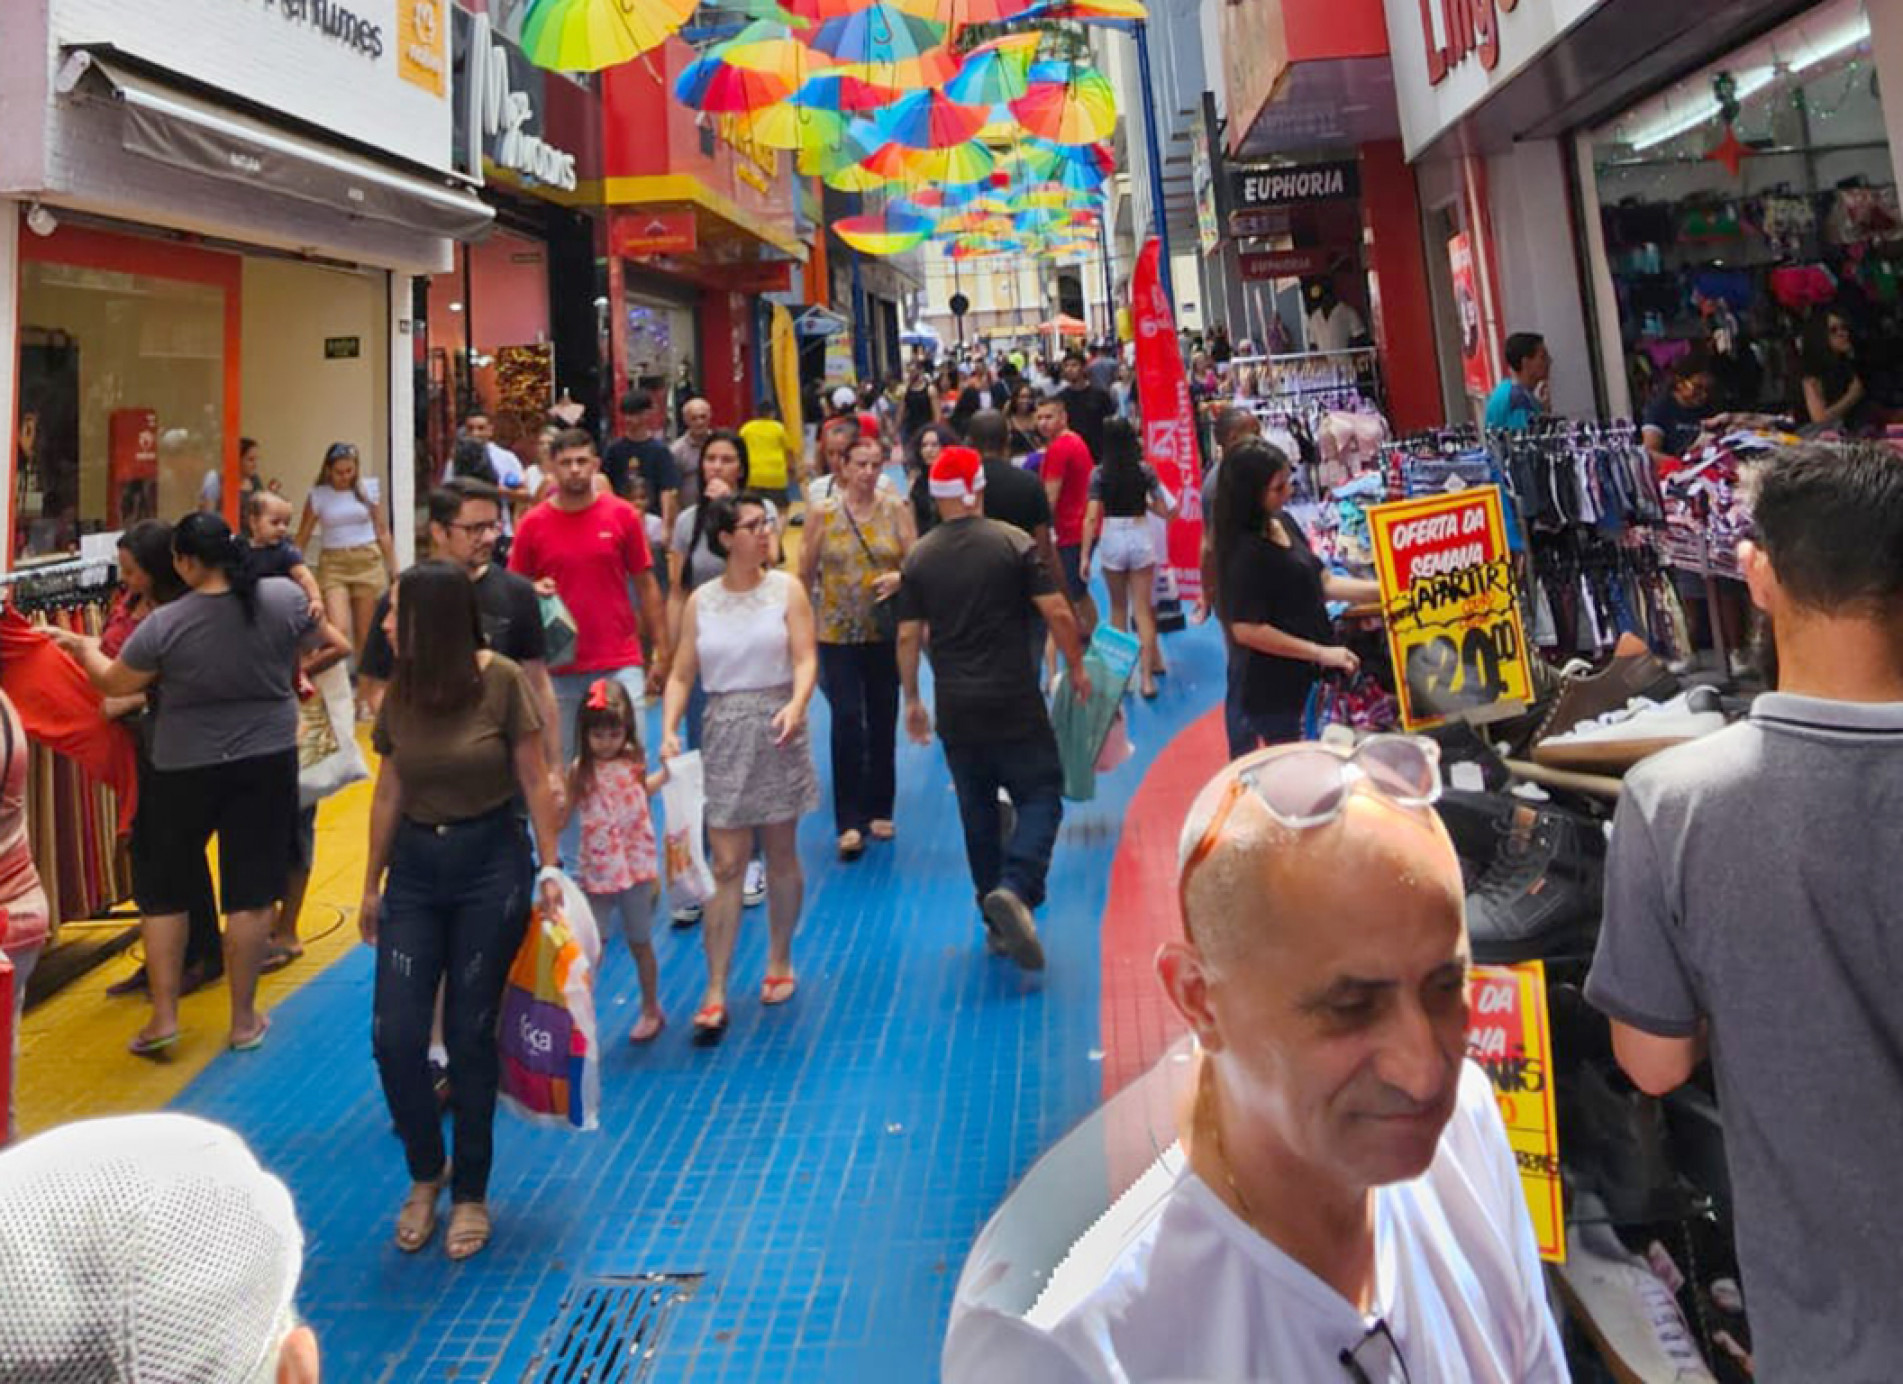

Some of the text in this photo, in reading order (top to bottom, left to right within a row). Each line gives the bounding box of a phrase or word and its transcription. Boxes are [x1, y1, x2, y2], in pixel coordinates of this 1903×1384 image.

[265, 0, 383, 58] erfumes
[1418, 0, 1518, 87] Ling
[1244, 169, 1343, 202] EUPHORIA
[1393, 506, 1486, 549] OFERTA DA
[1411, 542, 1484, 577] SEMANA
[1477, 983, 1513, 1014] DA
